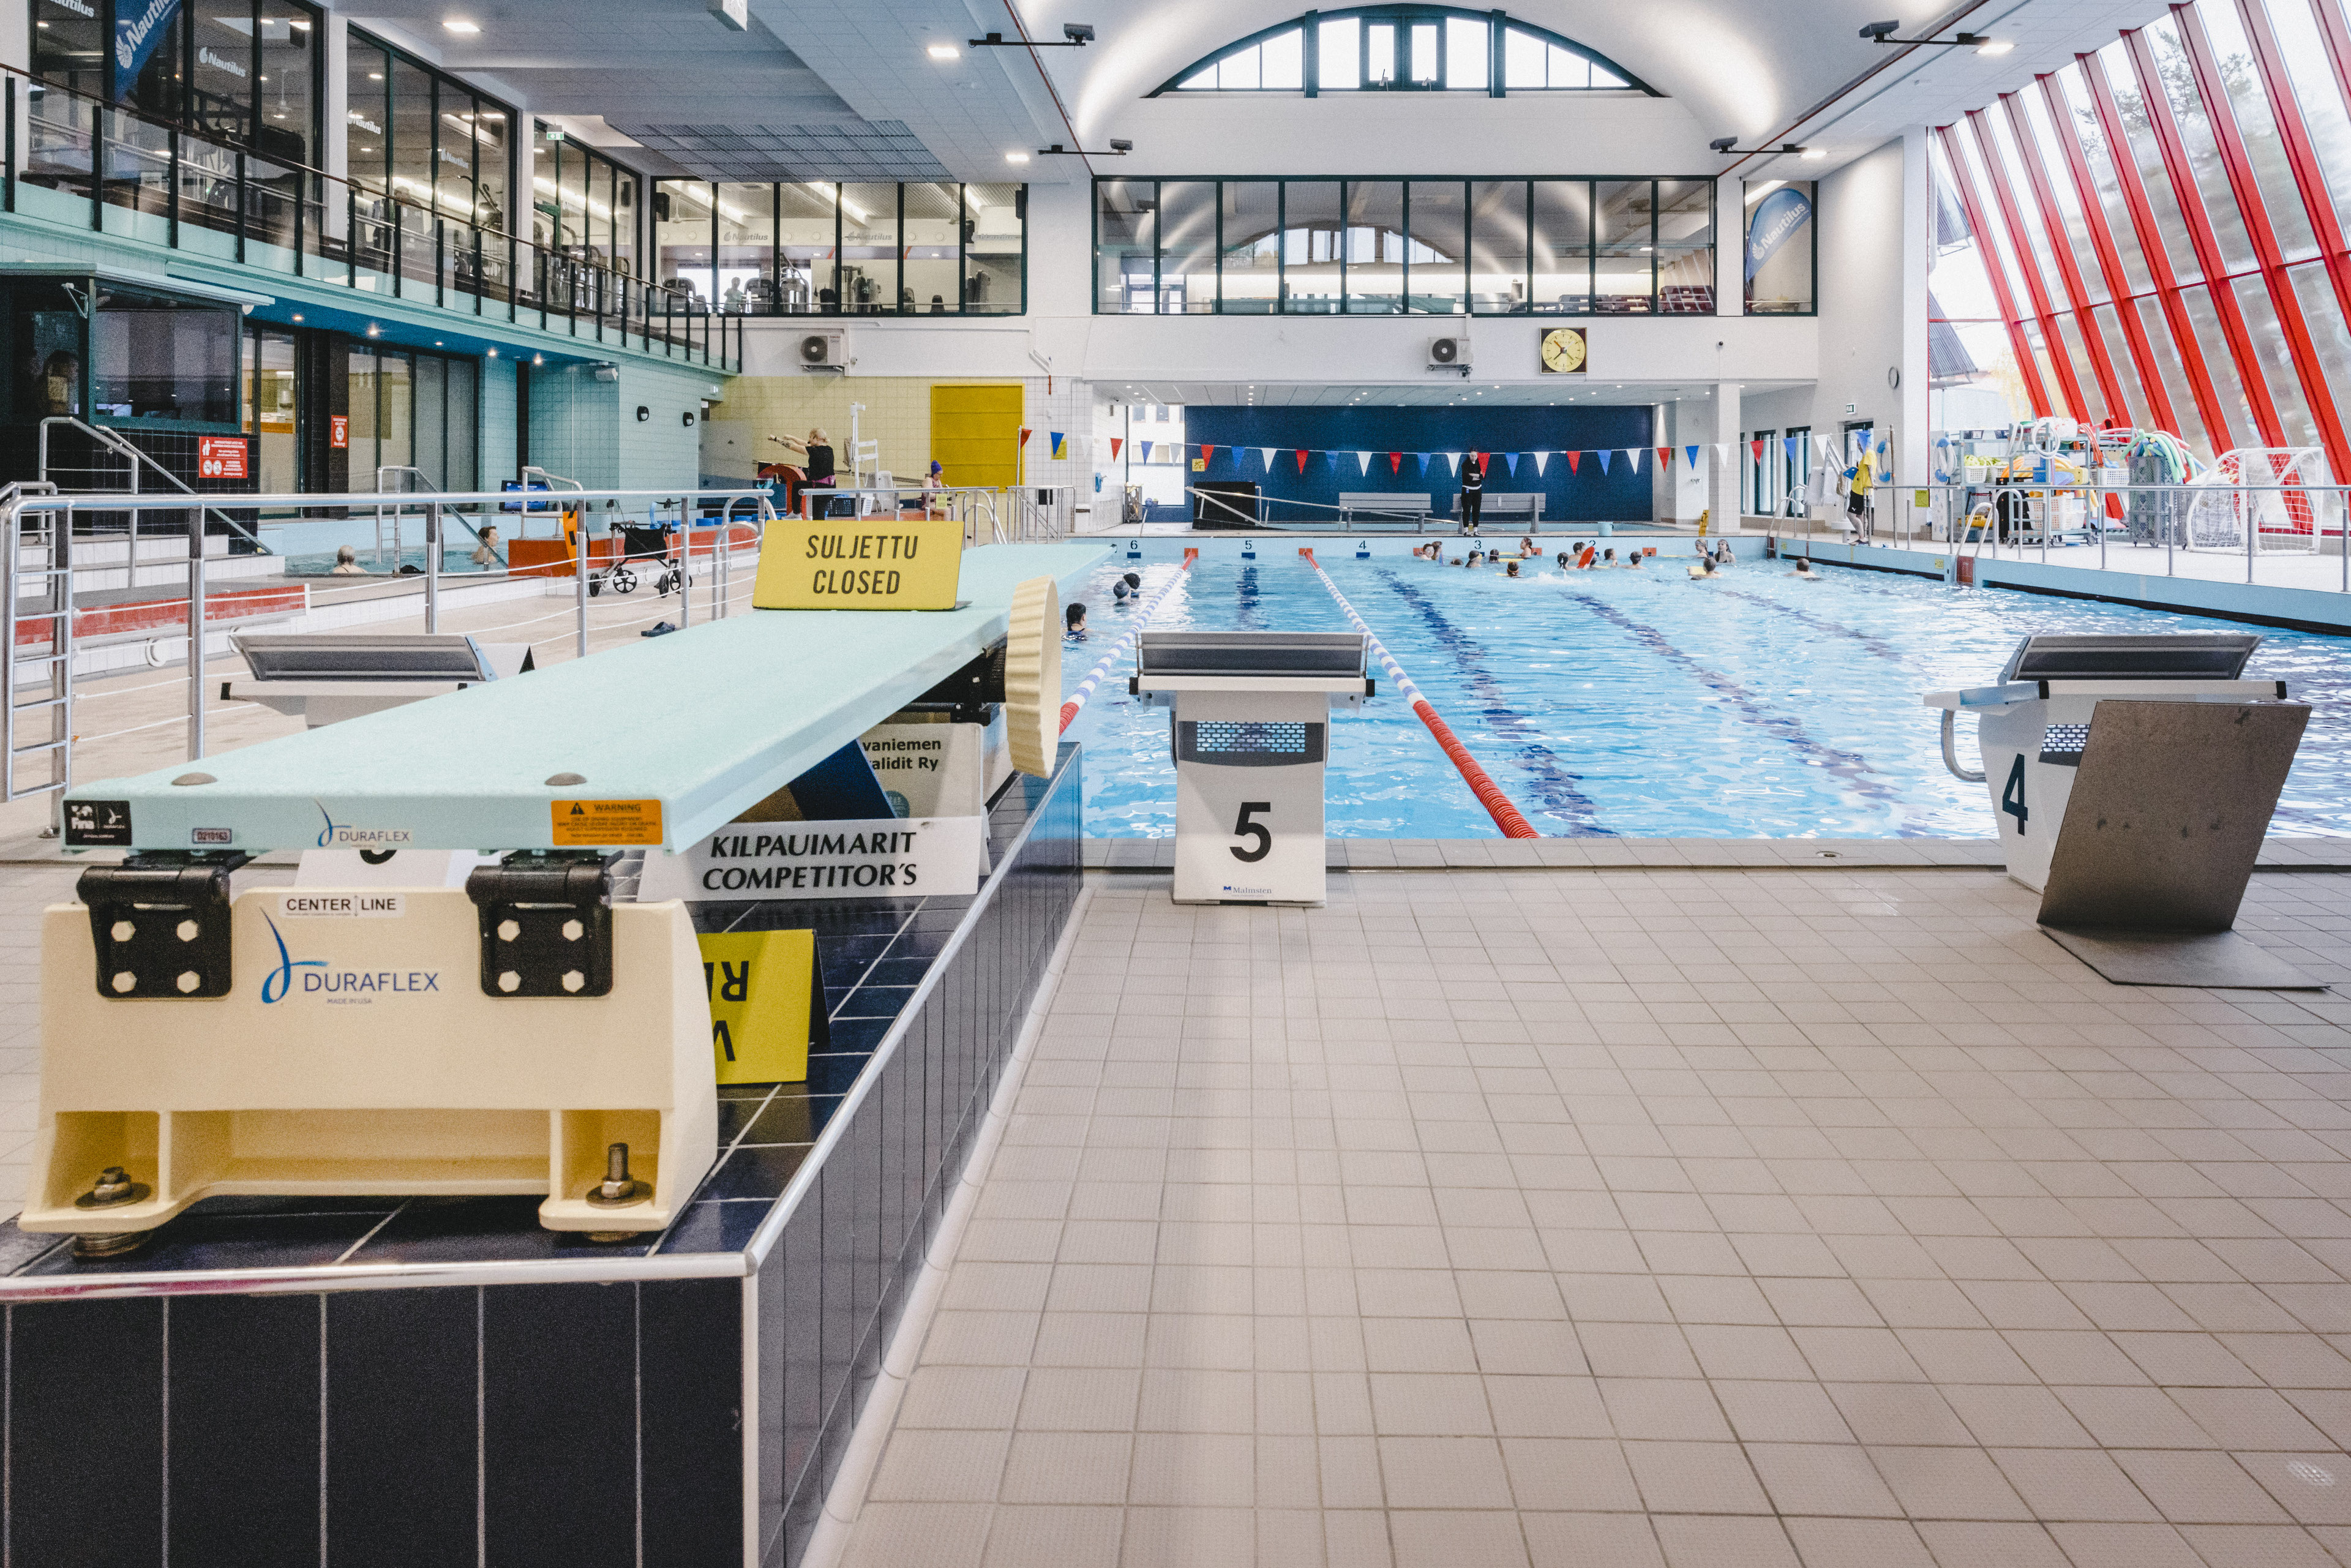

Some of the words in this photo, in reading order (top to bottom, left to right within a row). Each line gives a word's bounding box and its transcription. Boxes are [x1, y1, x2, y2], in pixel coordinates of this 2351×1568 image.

[209, 53, 246, 77] Nautilus
[1761, 203, 1806, 249] Nautilus
[806, 535, 918, 559] SULJETTU
[1130, 540, 1138, 550] 6
[1245, 540, 1252, 550] 5
[1359, 540, 1367, 549] 4
[1474, 540, 1482, 549] 3
[812, 570, 901, 595] CLOSED
[862, 738, 941, 751] vaniemen
[869, 757, 913, 770] alidit
[918, 757, 939, 771] Ry
[2002, 752, 2028, 836] 4
[339, 831, 410, 841] DURAFLEX
[1229, 802, 1272, 863] 5
[710, 831, 917, 858] KILPAUIMARIT
[702, 863, 917, 891] COMPETITOR'S
[287, 898, 351, 910] CENTER
[361, 898, 396, 910] LINE
[304, 973, 439, 992] DURAFLEX
